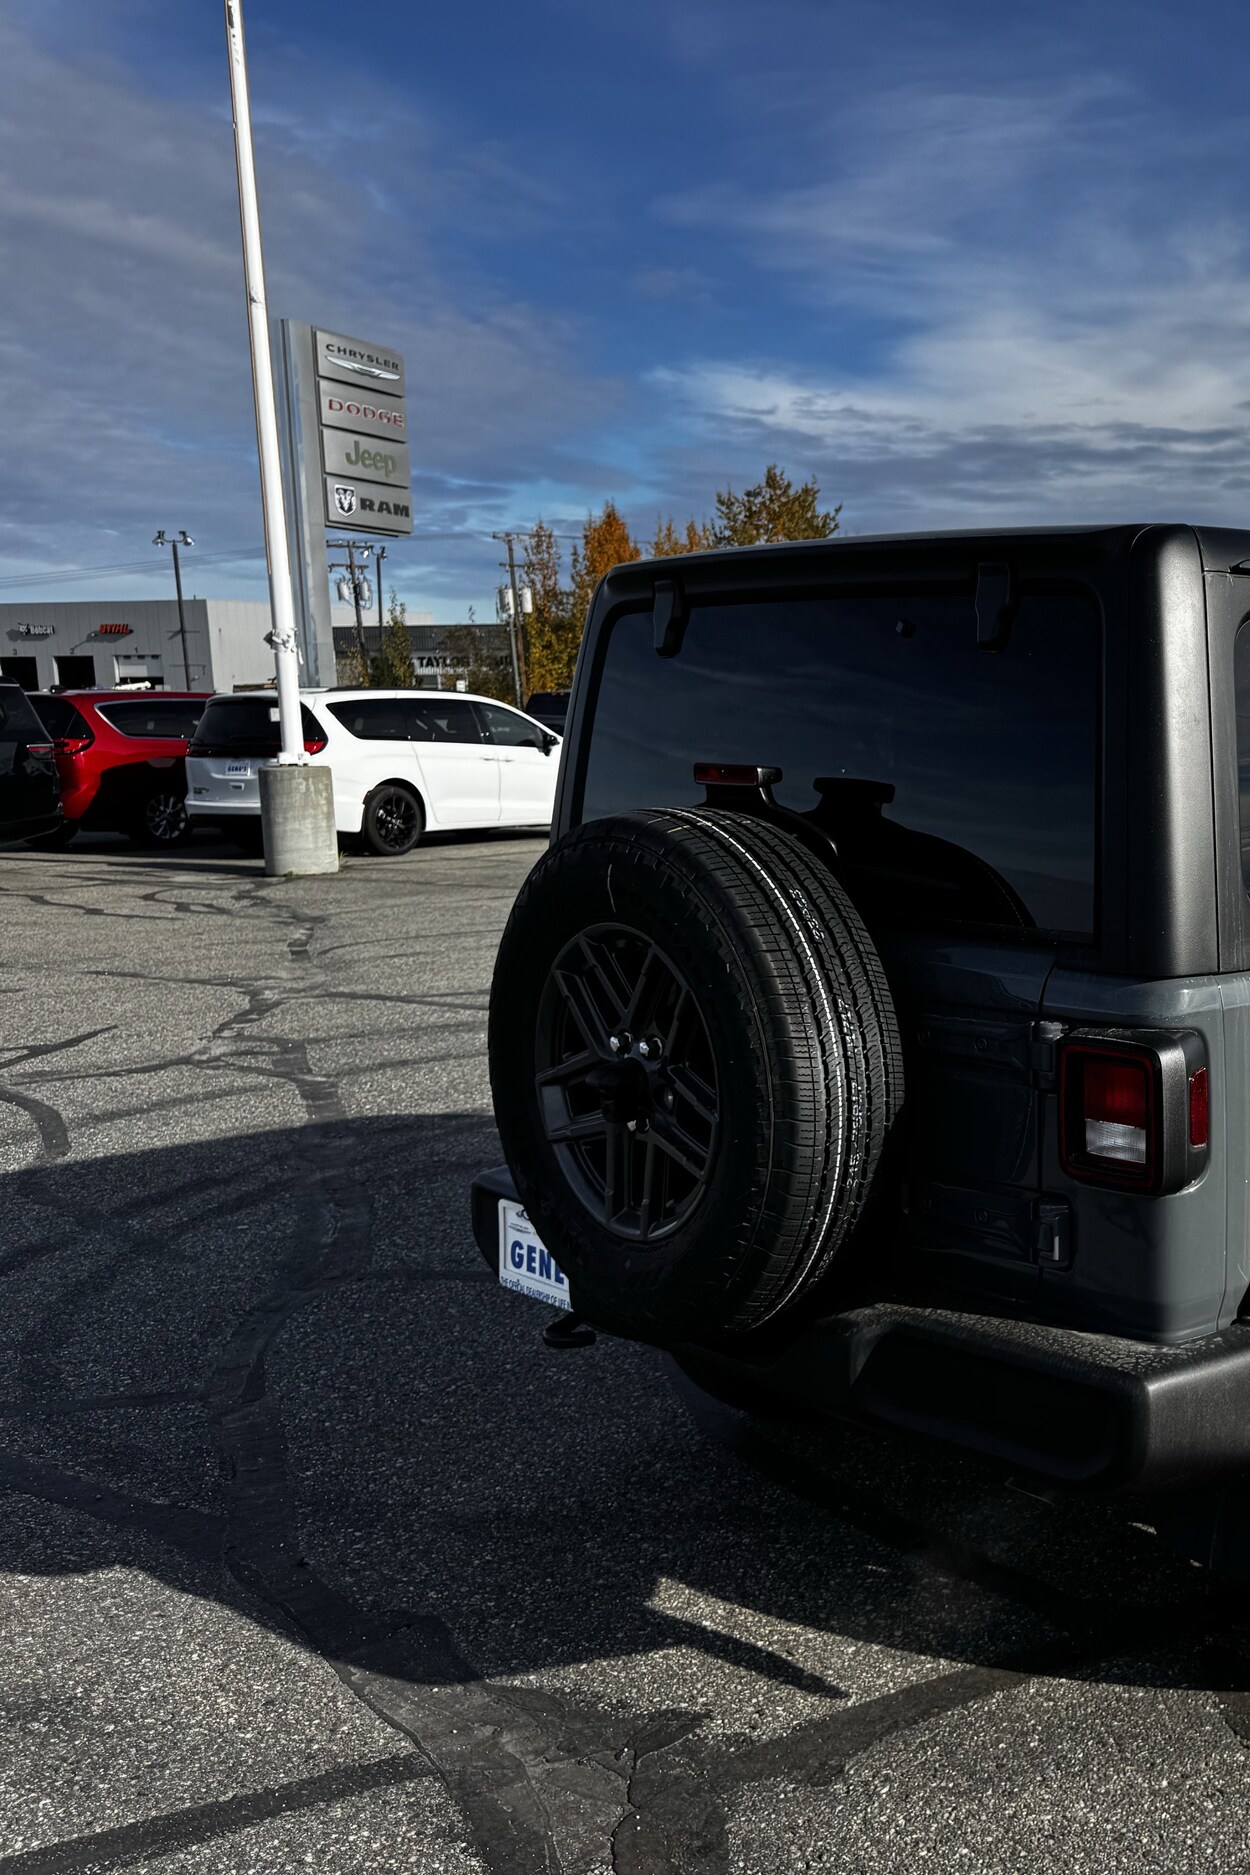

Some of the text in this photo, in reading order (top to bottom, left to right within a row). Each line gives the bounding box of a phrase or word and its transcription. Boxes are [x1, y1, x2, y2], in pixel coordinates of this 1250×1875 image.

[325, 343, 400, 371] CHRYSLER
[328, 398, 405, 427] DODGE
[345, 440, 398, 478] Jeep
[359, 497, 411, 518] RAM
[99, 623, 129, 635] STIHL
